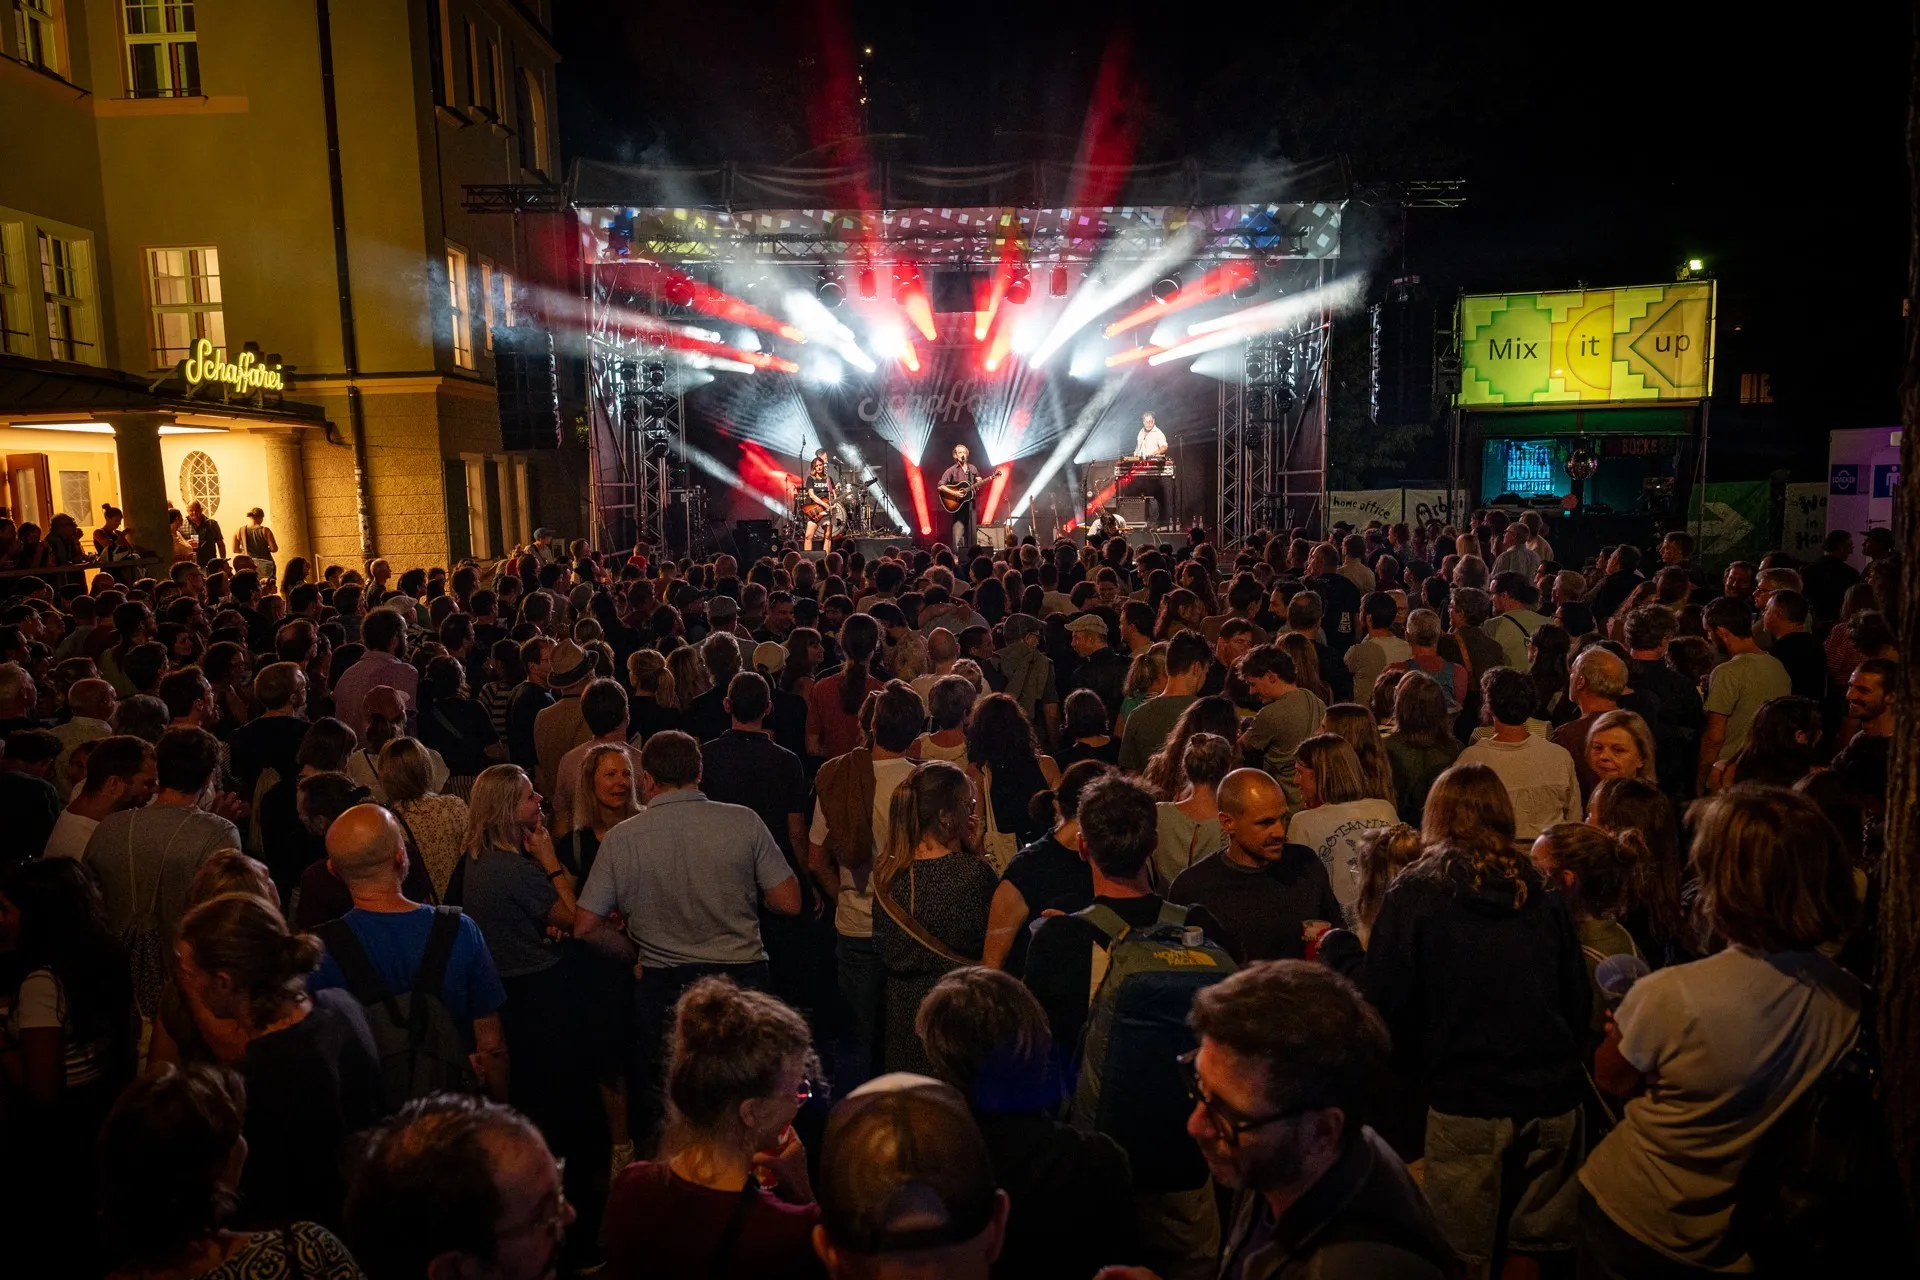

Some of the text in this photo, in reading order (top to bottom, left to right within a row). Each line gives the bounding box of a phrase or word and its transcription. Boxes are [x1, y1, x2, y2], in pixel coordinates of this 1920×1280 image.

[1489, 333, 1690, 360] Mix it up
[186, 338, 284, 393] Schaffarei
[1333, 497, 1390, 519] home office
